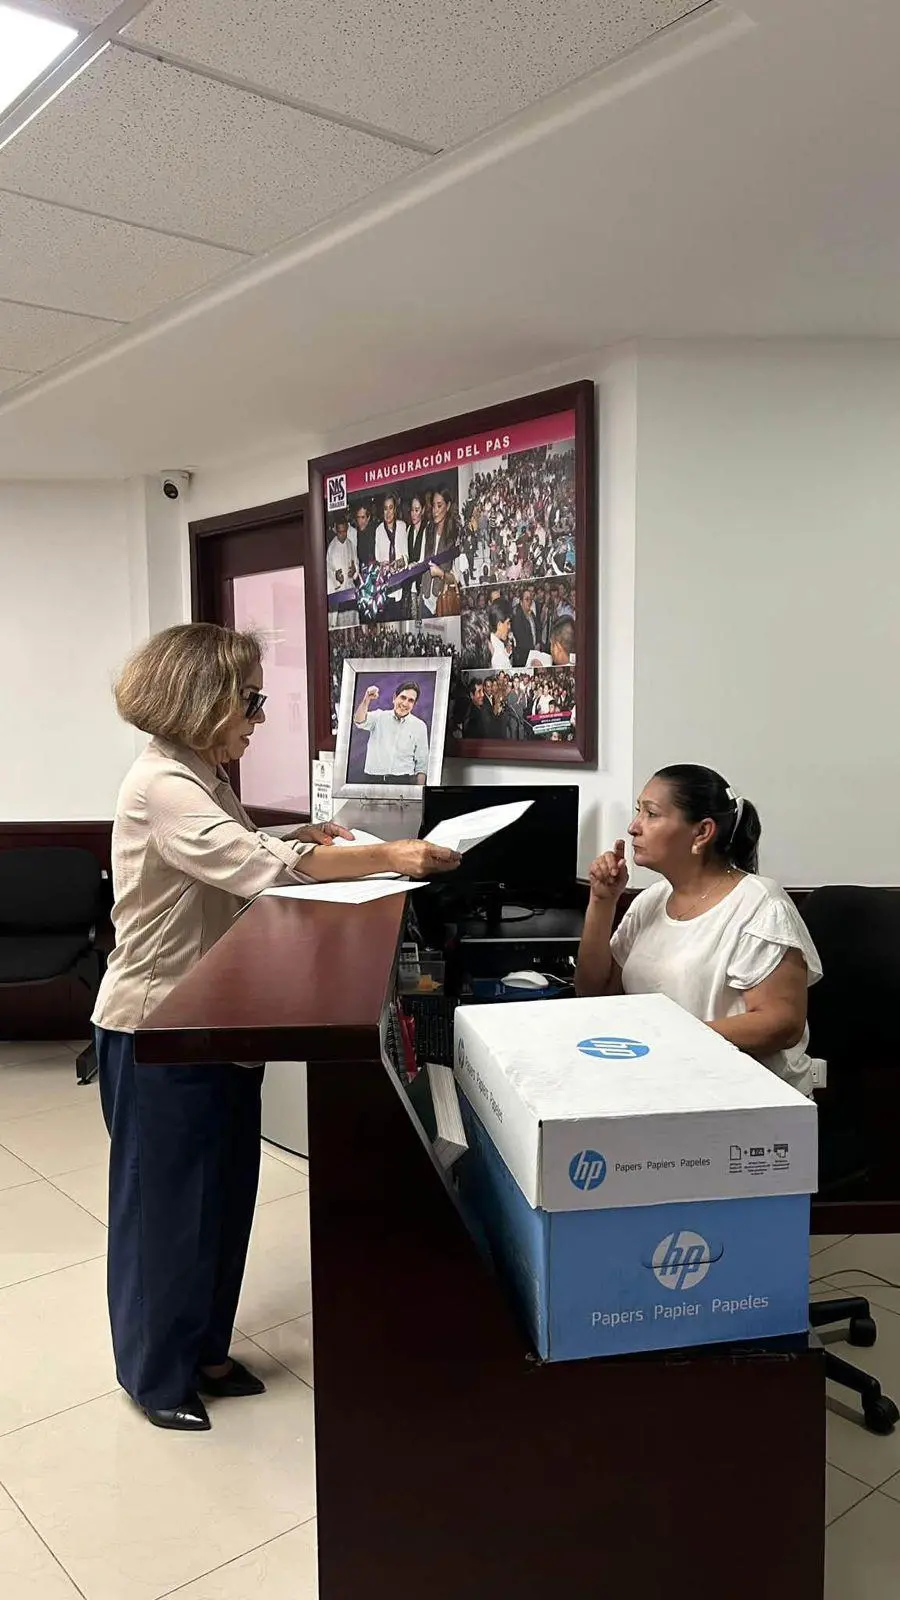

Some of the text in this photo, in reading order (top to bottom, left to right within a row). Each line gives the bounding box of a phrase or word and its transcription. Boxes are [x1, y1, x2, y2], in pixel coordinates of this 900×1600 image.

[364, 435, 510, 482] INAUGURACIÓN DEL PAS
[329, 477, 345, 502] PAS
[572, 1150, 711, 1191] hp Papers Papiers Papeles
[657, 1231, 707, 1290] hp
[592, 1294, 769, 1327] Papers Papier Papeles
